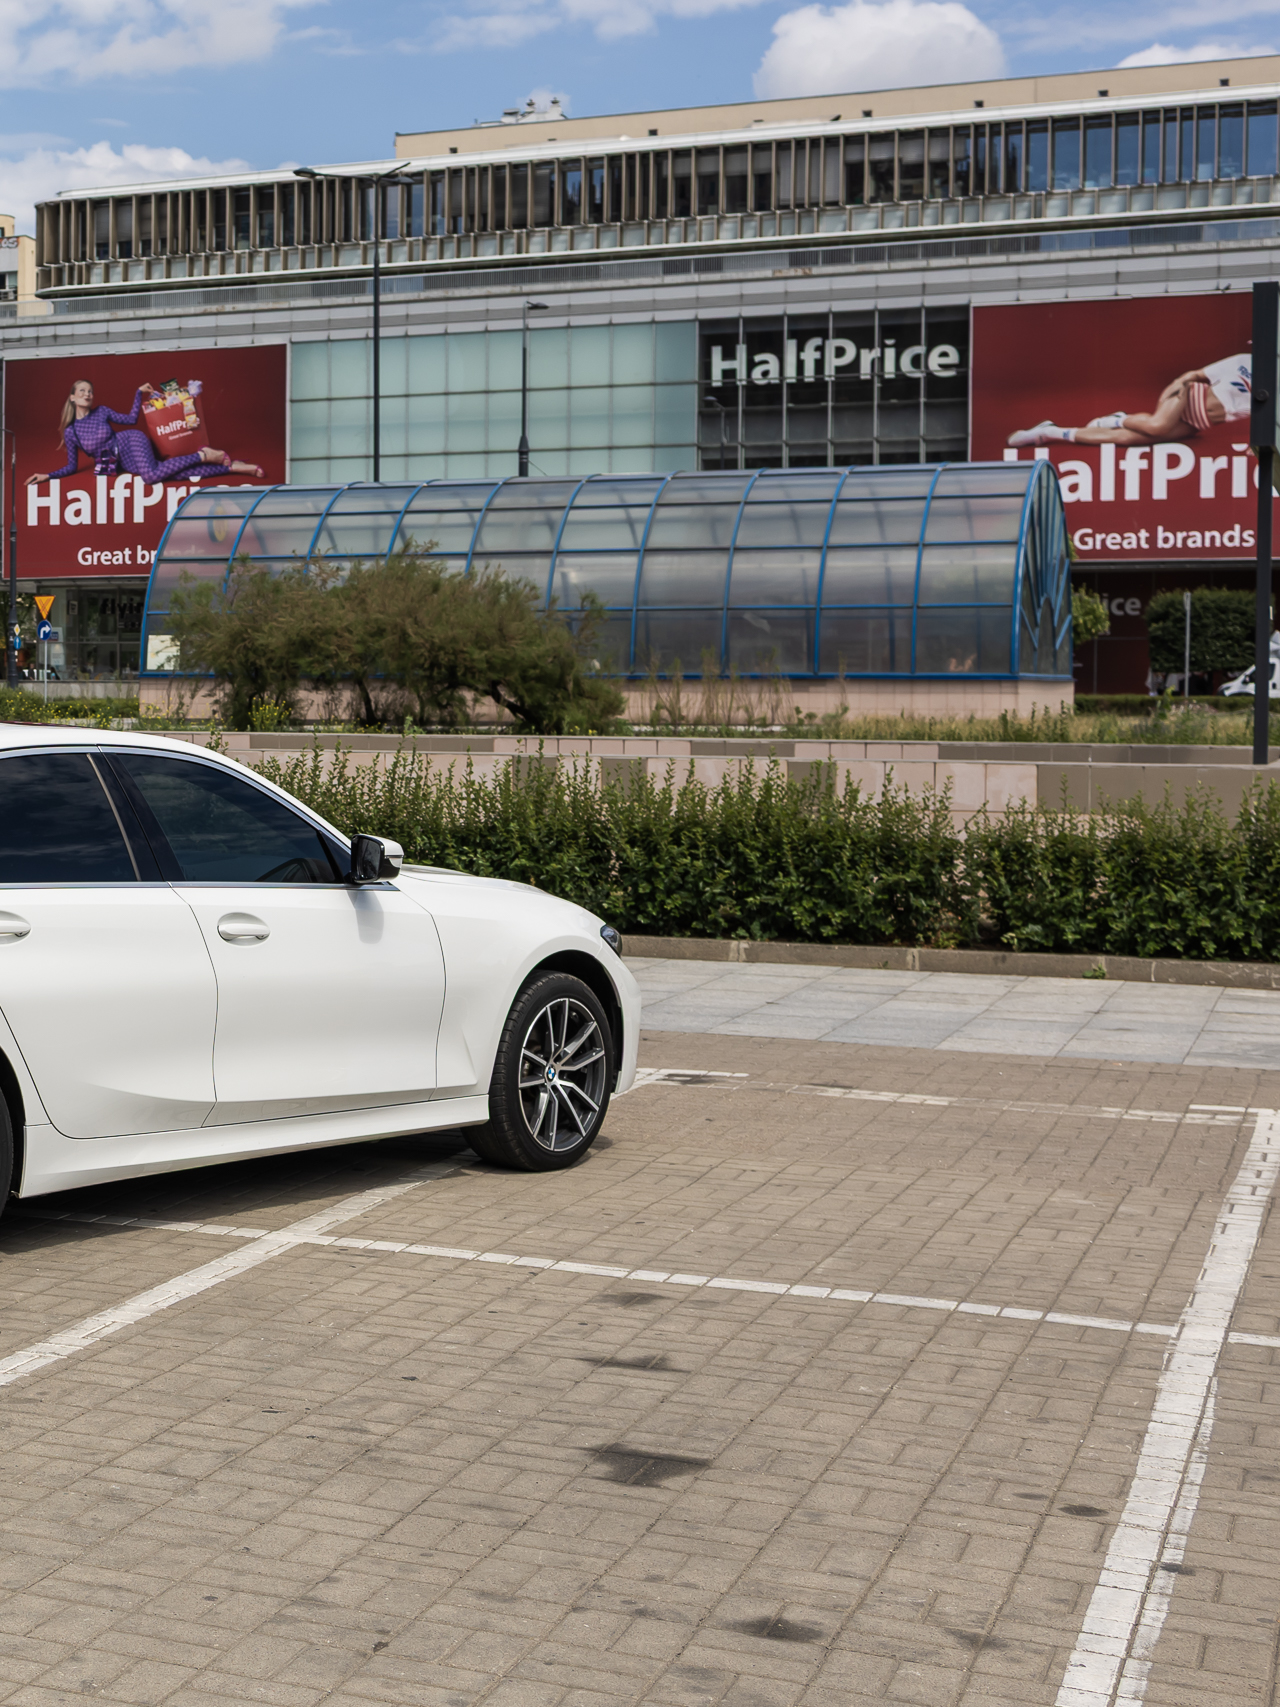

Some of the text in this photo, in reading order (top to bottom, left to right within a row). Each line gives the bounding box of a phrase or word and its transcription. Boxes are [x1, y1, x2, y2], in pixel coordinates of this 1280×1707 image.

[711, 337, 960, 387] HalfPrice
[1073, 523, 1255, 550] Great brands
[77, 547, 132, 566] Great
